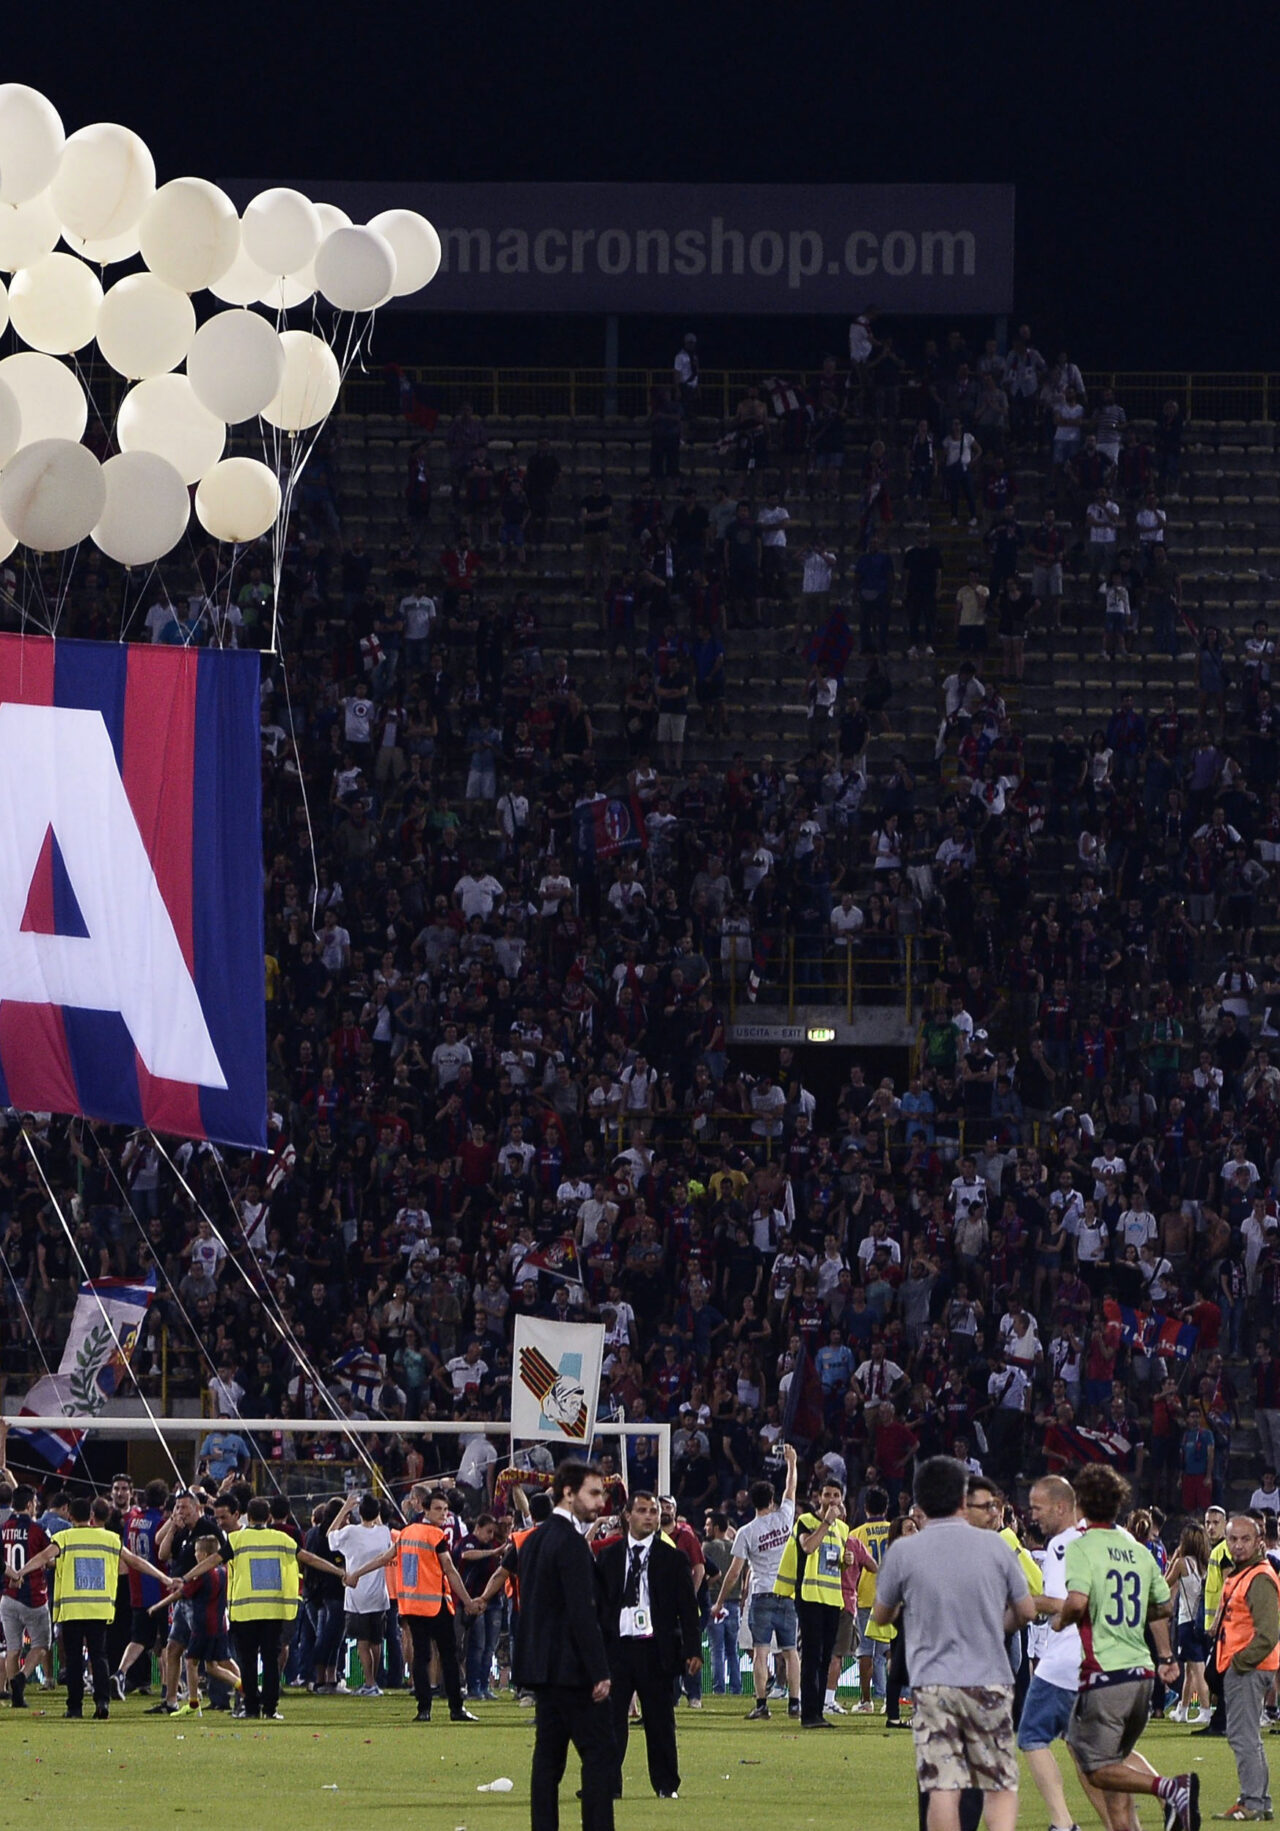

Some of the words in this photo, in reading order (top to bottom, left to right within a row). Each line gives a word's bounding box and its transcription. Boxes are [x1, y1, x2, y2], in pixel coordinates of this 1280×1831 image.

[439, 216, 976, 289] macronshop.com
[736, 1027, 770, 1038] USCITA
[782, 1028, 801, 1038] EXIT
[1, 1528, 28, 1541] VITALE
[3, 1543, 26, 1574] 10
[1107, 1547, 1137, 1564] KONE
[1105, 1569, 1141, 1627] 33
